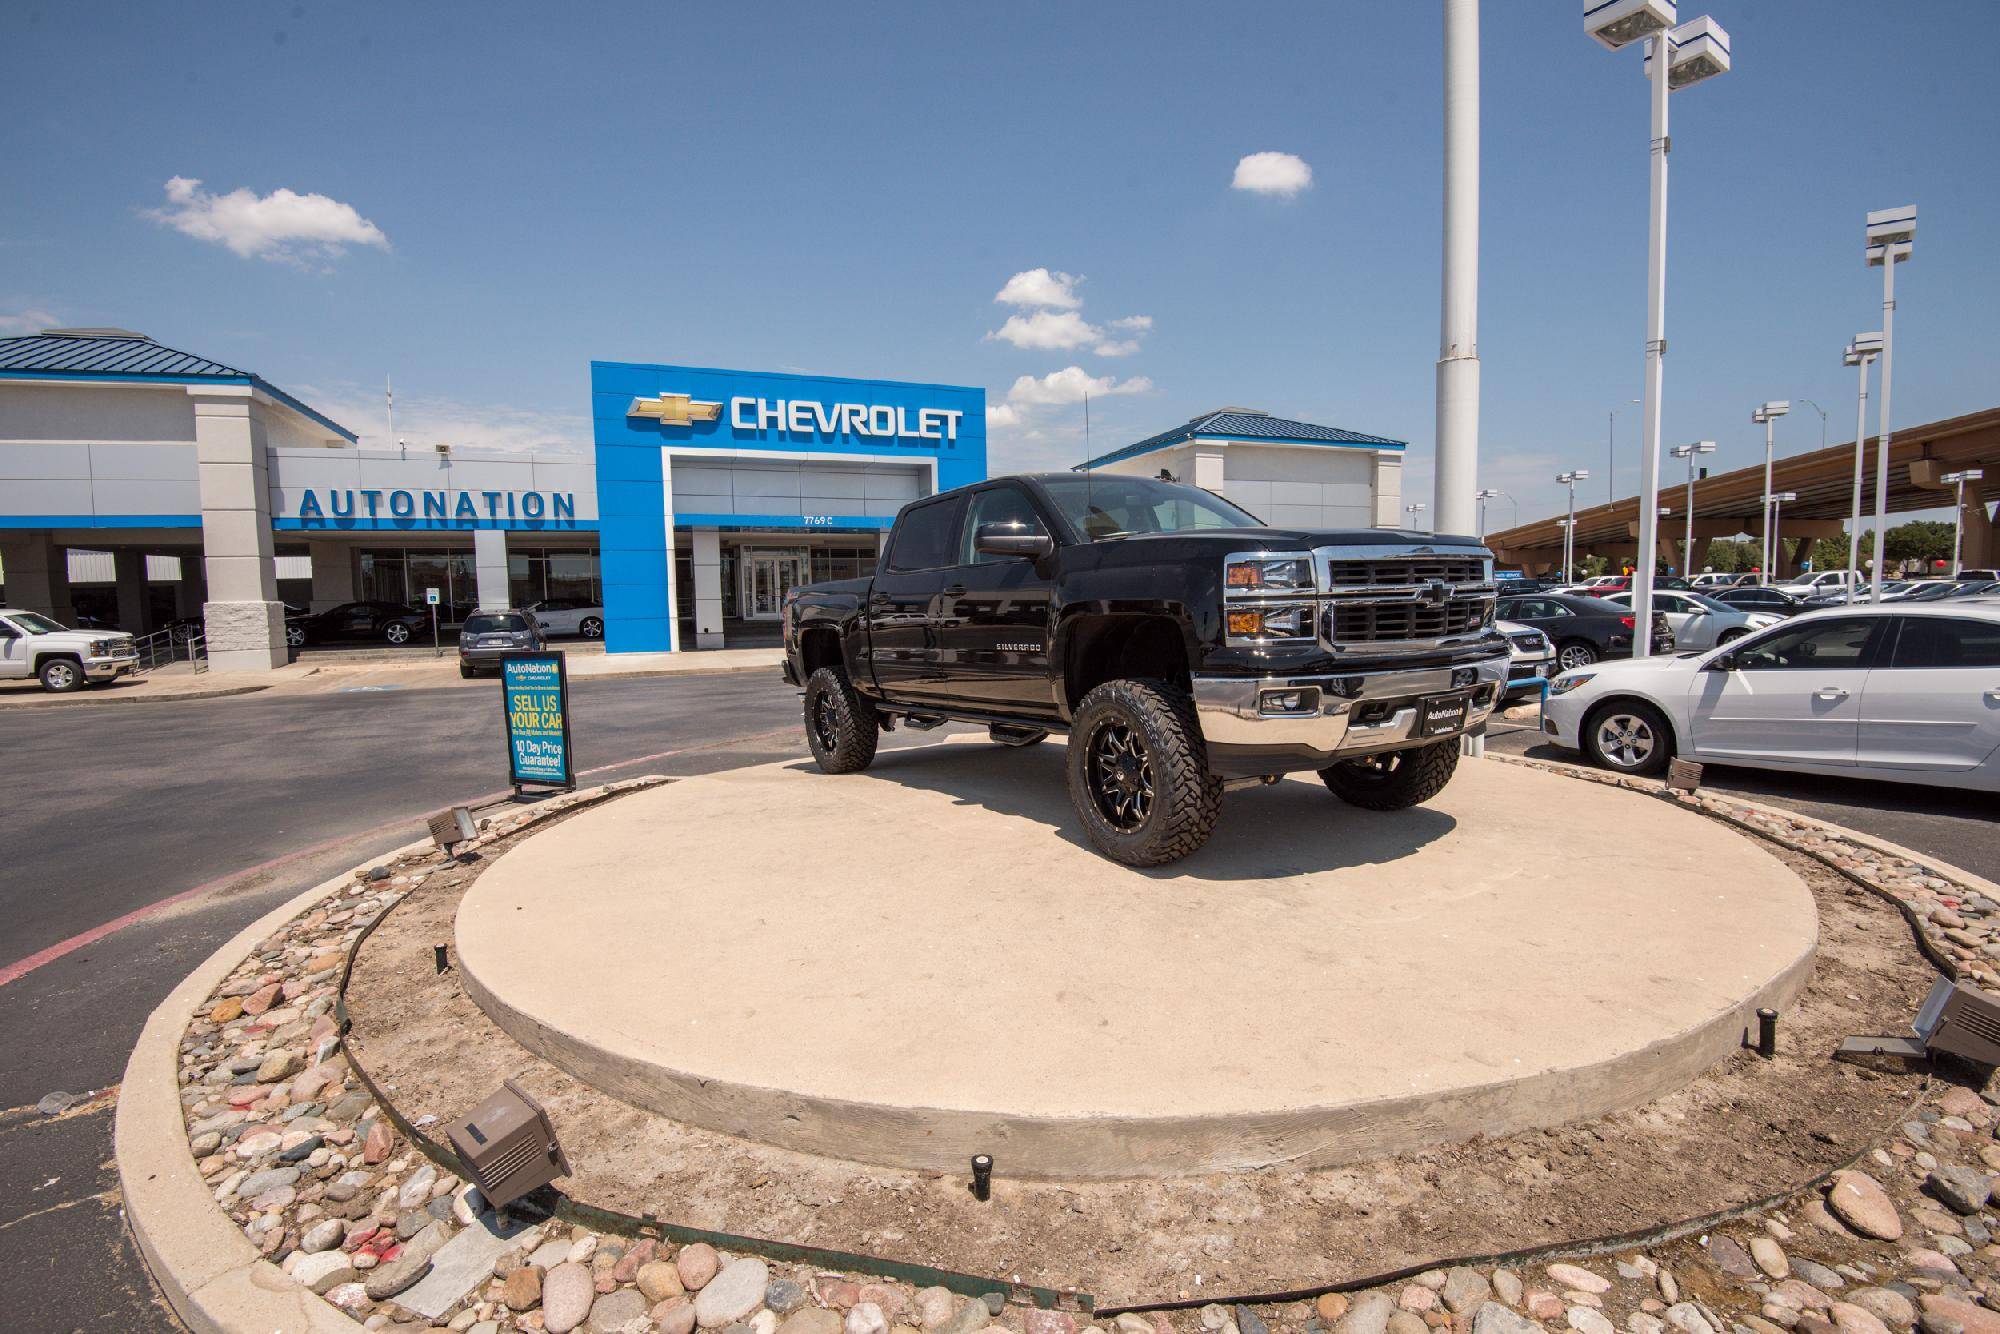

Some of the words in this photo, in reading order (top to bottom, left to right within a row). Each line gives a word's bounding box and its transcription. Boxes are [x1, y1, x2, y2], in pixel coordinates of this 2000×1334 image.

[731, 396, 963, 440] CHEVROLET
[300, 489, 574, 518] AUTONATION
[804, 516, 825, 525] 7769
[996, 643, 1041, 651] SILVERADO
[507, 663, 551, 674] AutoNation
[513, 694, 541, 712] SELL
[542, 694, 557, 712] US
[509, 711, 539, 728] YOUR
[541, 712, 563, 729] CAR
[1427, 708, 1459, 720] AutoNation
[516, 740, 525, 752] 10
[526, 740, 541, 755] Day
[542, 741, 562, 754] Price
